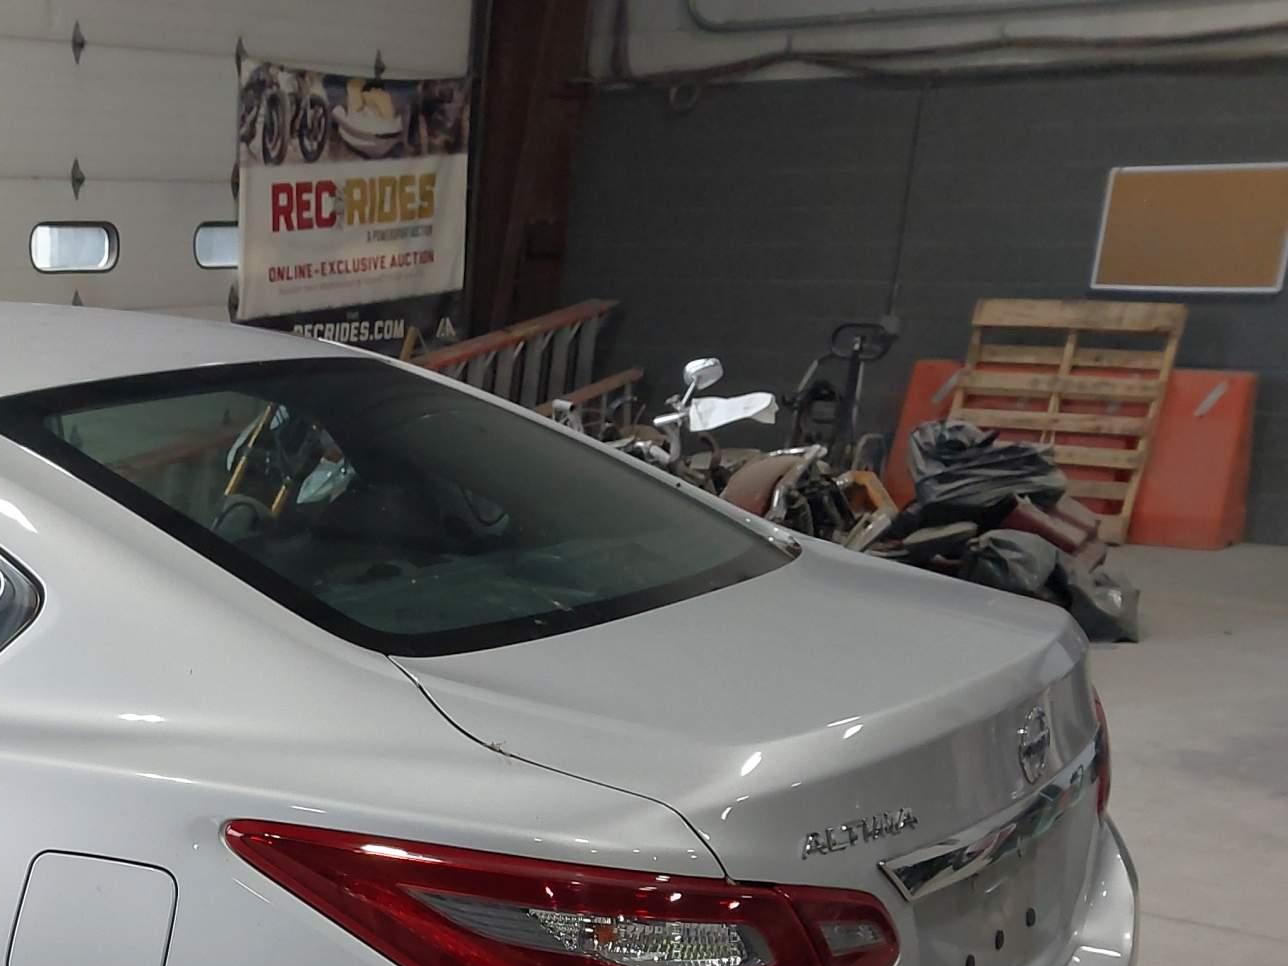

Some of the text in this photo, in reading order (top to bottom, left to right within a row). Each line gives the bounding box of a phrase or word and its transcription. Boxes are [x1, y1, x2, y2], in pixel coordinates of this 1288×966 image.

[271, 172, 437, 232] REC RIDES
[268, 255, 386, 282] ONLINE-EXCLUSIVE
[390, 249, 435, 268] AUCTION
[801, 807, 919, 860] ALTIMA
